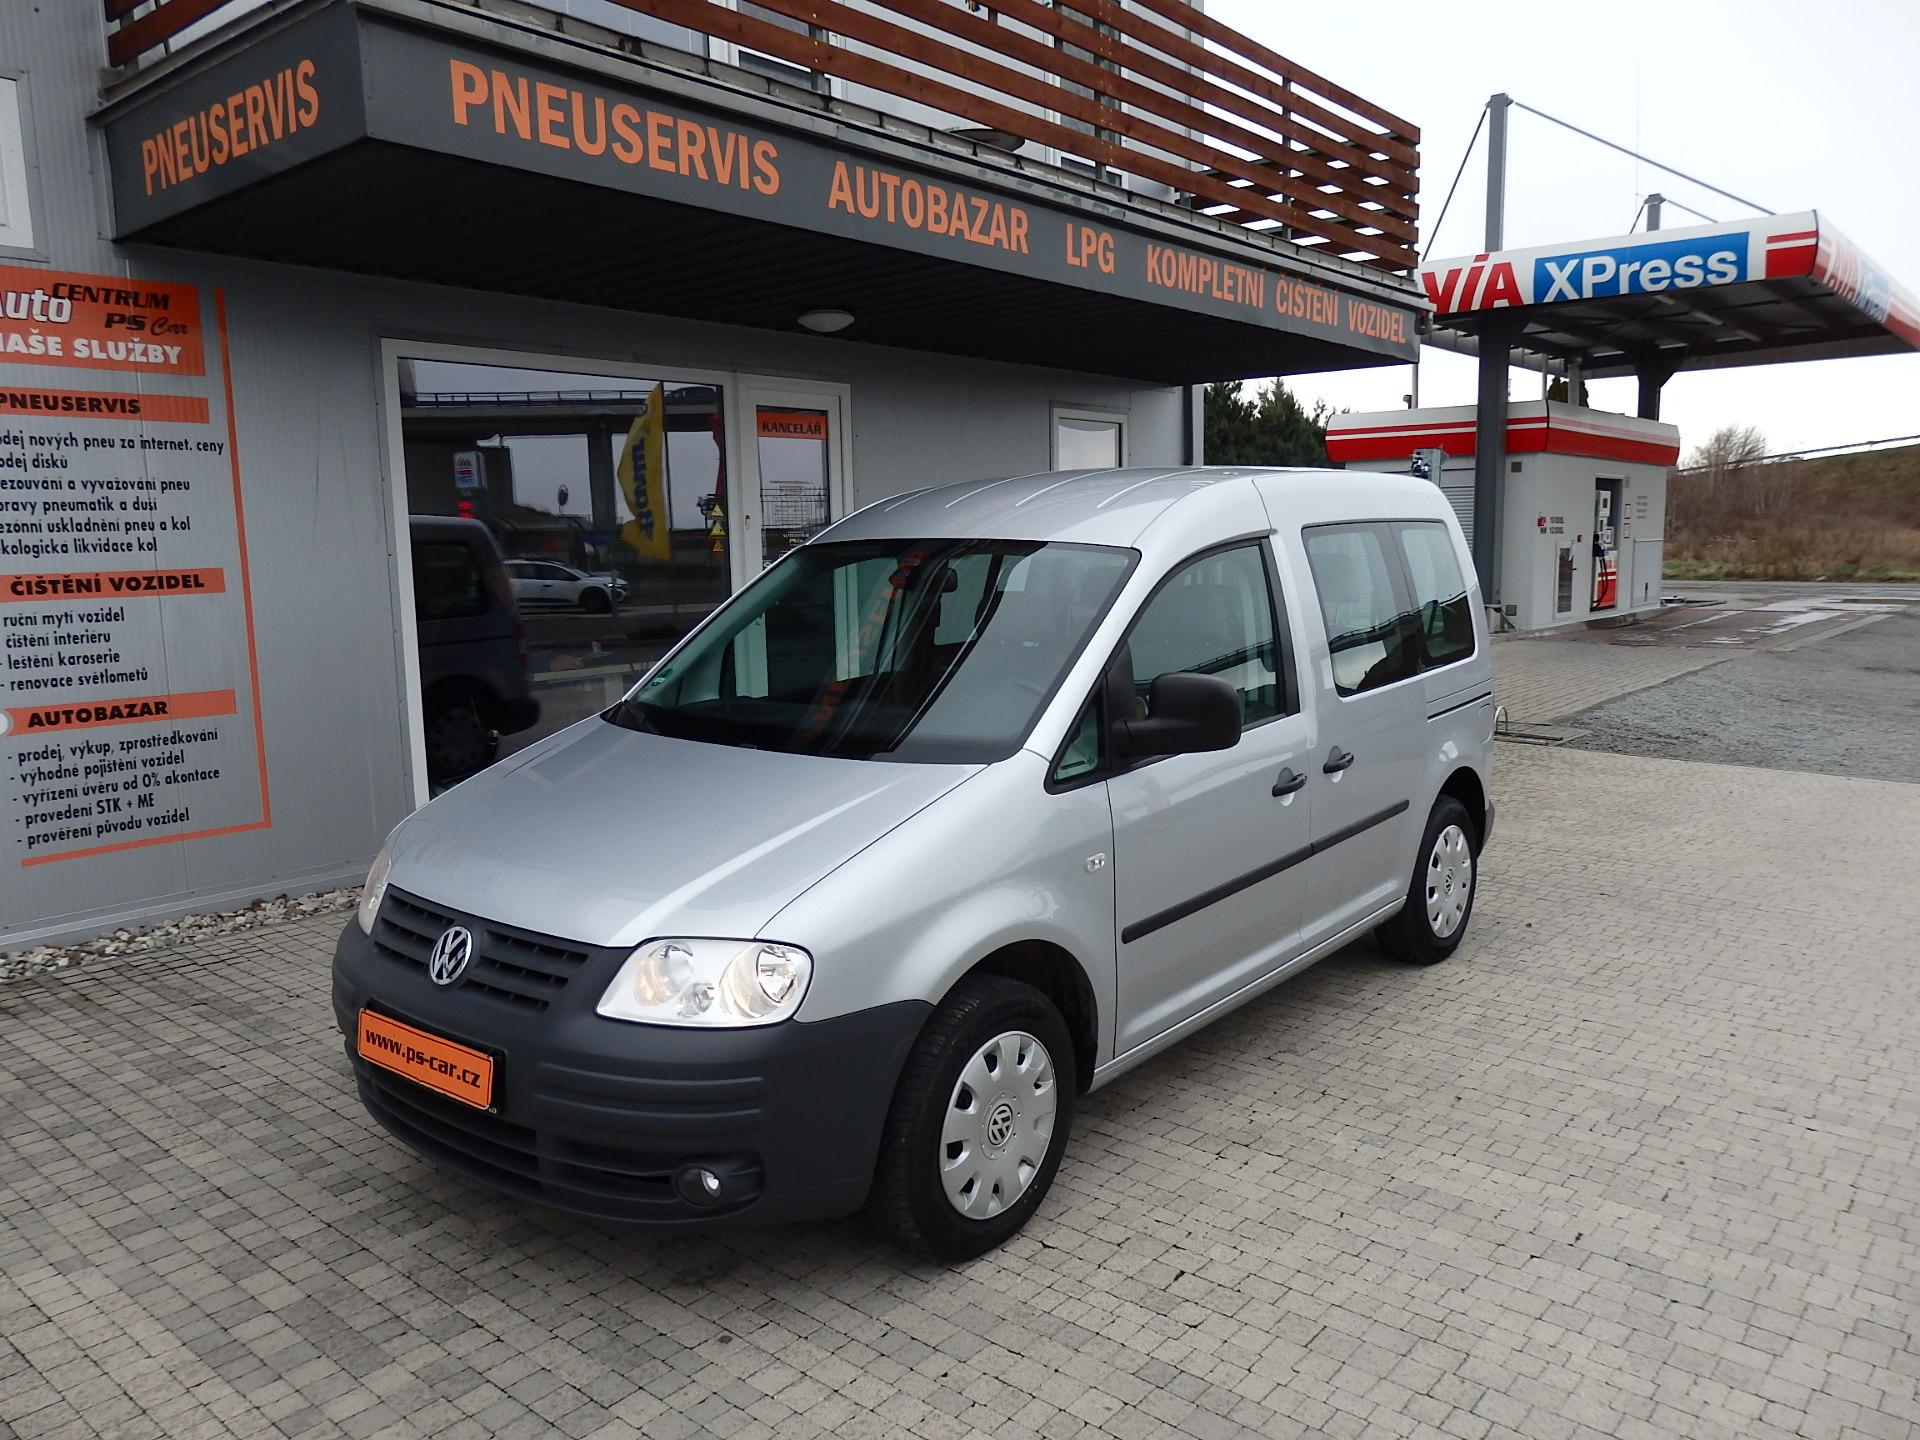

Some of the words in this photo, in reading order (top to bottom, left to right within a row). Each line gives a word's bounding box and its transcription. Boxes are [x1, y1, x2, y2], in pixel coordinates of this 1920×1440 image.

[142, 59, 319, 196] PNEUSERVIS
[448, 59, 780, 195] PNEUSERVIS
[828, 161, 1029, 255] AUTOBAZAR
[1066, 223, 1115, 273] LPG
[1147, 244, 1266, 309] KOMPLETNÍ
[1275, 271, 1339, 327] ČIŠTĚNÍ
[1348, 299, 1406, 344] VOZIDEL
[1544, 250, 1737, 303] XPress
[53, 283, 170, 311] CENTRUM
[104, 313, 147, 331] PS
[150, 317, 190, 337] Car
[73, 336, 182, 365] SLUŽBY
[762, 421, 822, 435] KANCELÁŘ
[29, 431, 78, 450] nových
[84, 437, 115, 451] pneu
[120, 438, 135, 449] za
[140, 434, 192, 451] internet.
[196, 441, 224, 456] ceny
[68, 480, 76, 490] a
[81, 476, 156, 494] vyvažování
[161, 480, 190, 494] pneu
[43, 496, 115, 515] pneumatik
[120, 501, 128, 511] a
[47, 517, 120, 533] uskladnění
[125, 521, 155, 535] pneu
[160, 521, 167, 531] a
[171, 516, 191, 531] kol
[74, 538, 133, 553] likvidace
[137, 537, 157, 552] kol
[10, 573, 102, 596] ČIŠTĚNÍ
[109, 574, 205, 592] VOZIDEL
[3, 612, 38, 627] ruční
[42, 610, 74, 628] mytí
[78, 606, 125, 623] vozidel
[6, 631, 49, 648] čištění
[54, 629, 111, 645] interiéru
[7, 653, 54, 669] leštění
[58, 648, 120, 666] karoserie
[10, 676, 73, 691] renovace
[79, 667, 148, 686] světlometů
[28, 701, 169, 728] AUTOBAZAR
[18, 743, 65, 767] prodej,
[70, 740, 114, 760] výkup,
[119, 727, 218, 754] zprostředkování
[20, 763, 79, 786] výhodné
[84, 757, 137, 779] pojištění
[141, 749, 185, 768] vozidel
[22, 784, 78, 807] vyřízení
[82, 781, 118, 797] úvěru
[123, 775, 138, 790] od
[142, 772, 160, 788] 0%
[165, 769, 220, 785] akontace
[25, 803, 92, 829] provedení
[96, 797, 122, 815] STK
[28, 823, 92, 849] prověření
[96, 815, 142, 838] původu
[146, 807, 189, 827] vozidel
[365, 1029, 481, 1089] www.ps-car.cz
